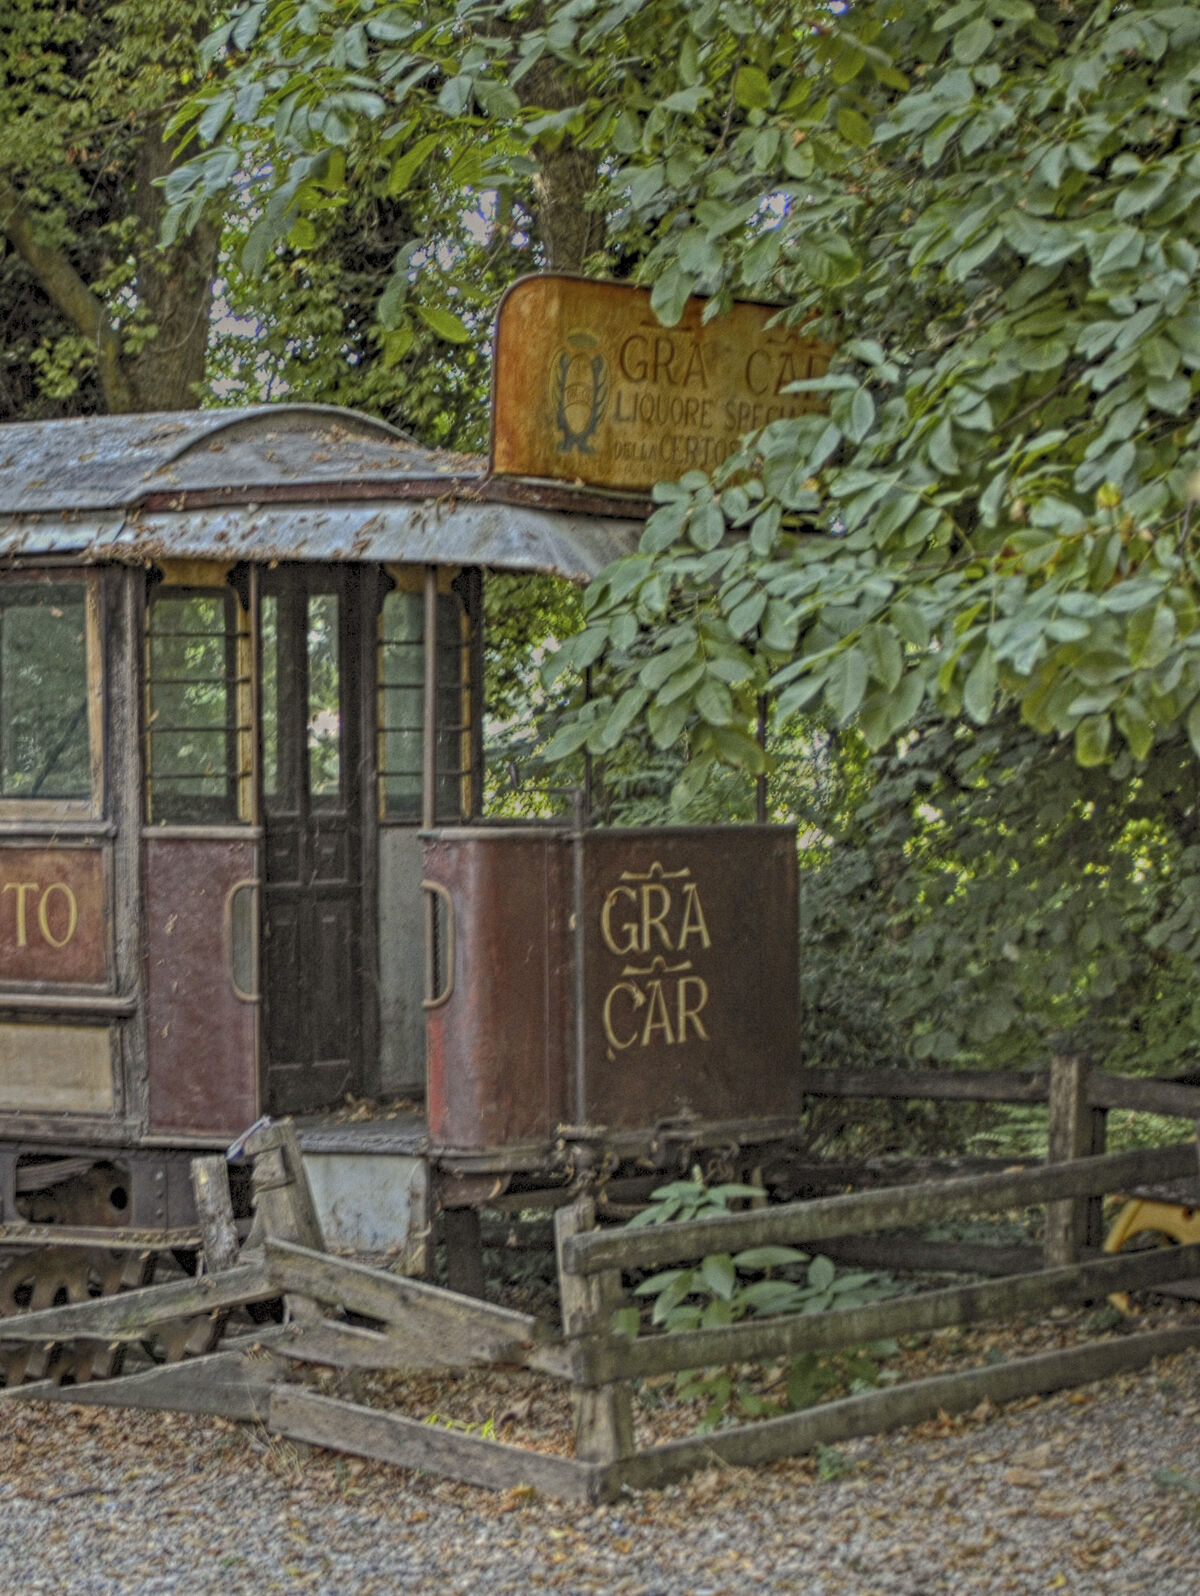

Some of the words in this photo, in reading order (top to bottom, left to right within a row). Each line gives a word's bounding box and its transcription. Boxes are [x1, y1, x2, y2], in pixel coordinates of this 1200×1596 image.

[619, 333, 708, 389] GRA
[612, 389, 713, 431] LIQUORE
[601, 882, 711, 955] GRA
[603, 976, 710, 1049] CAR
